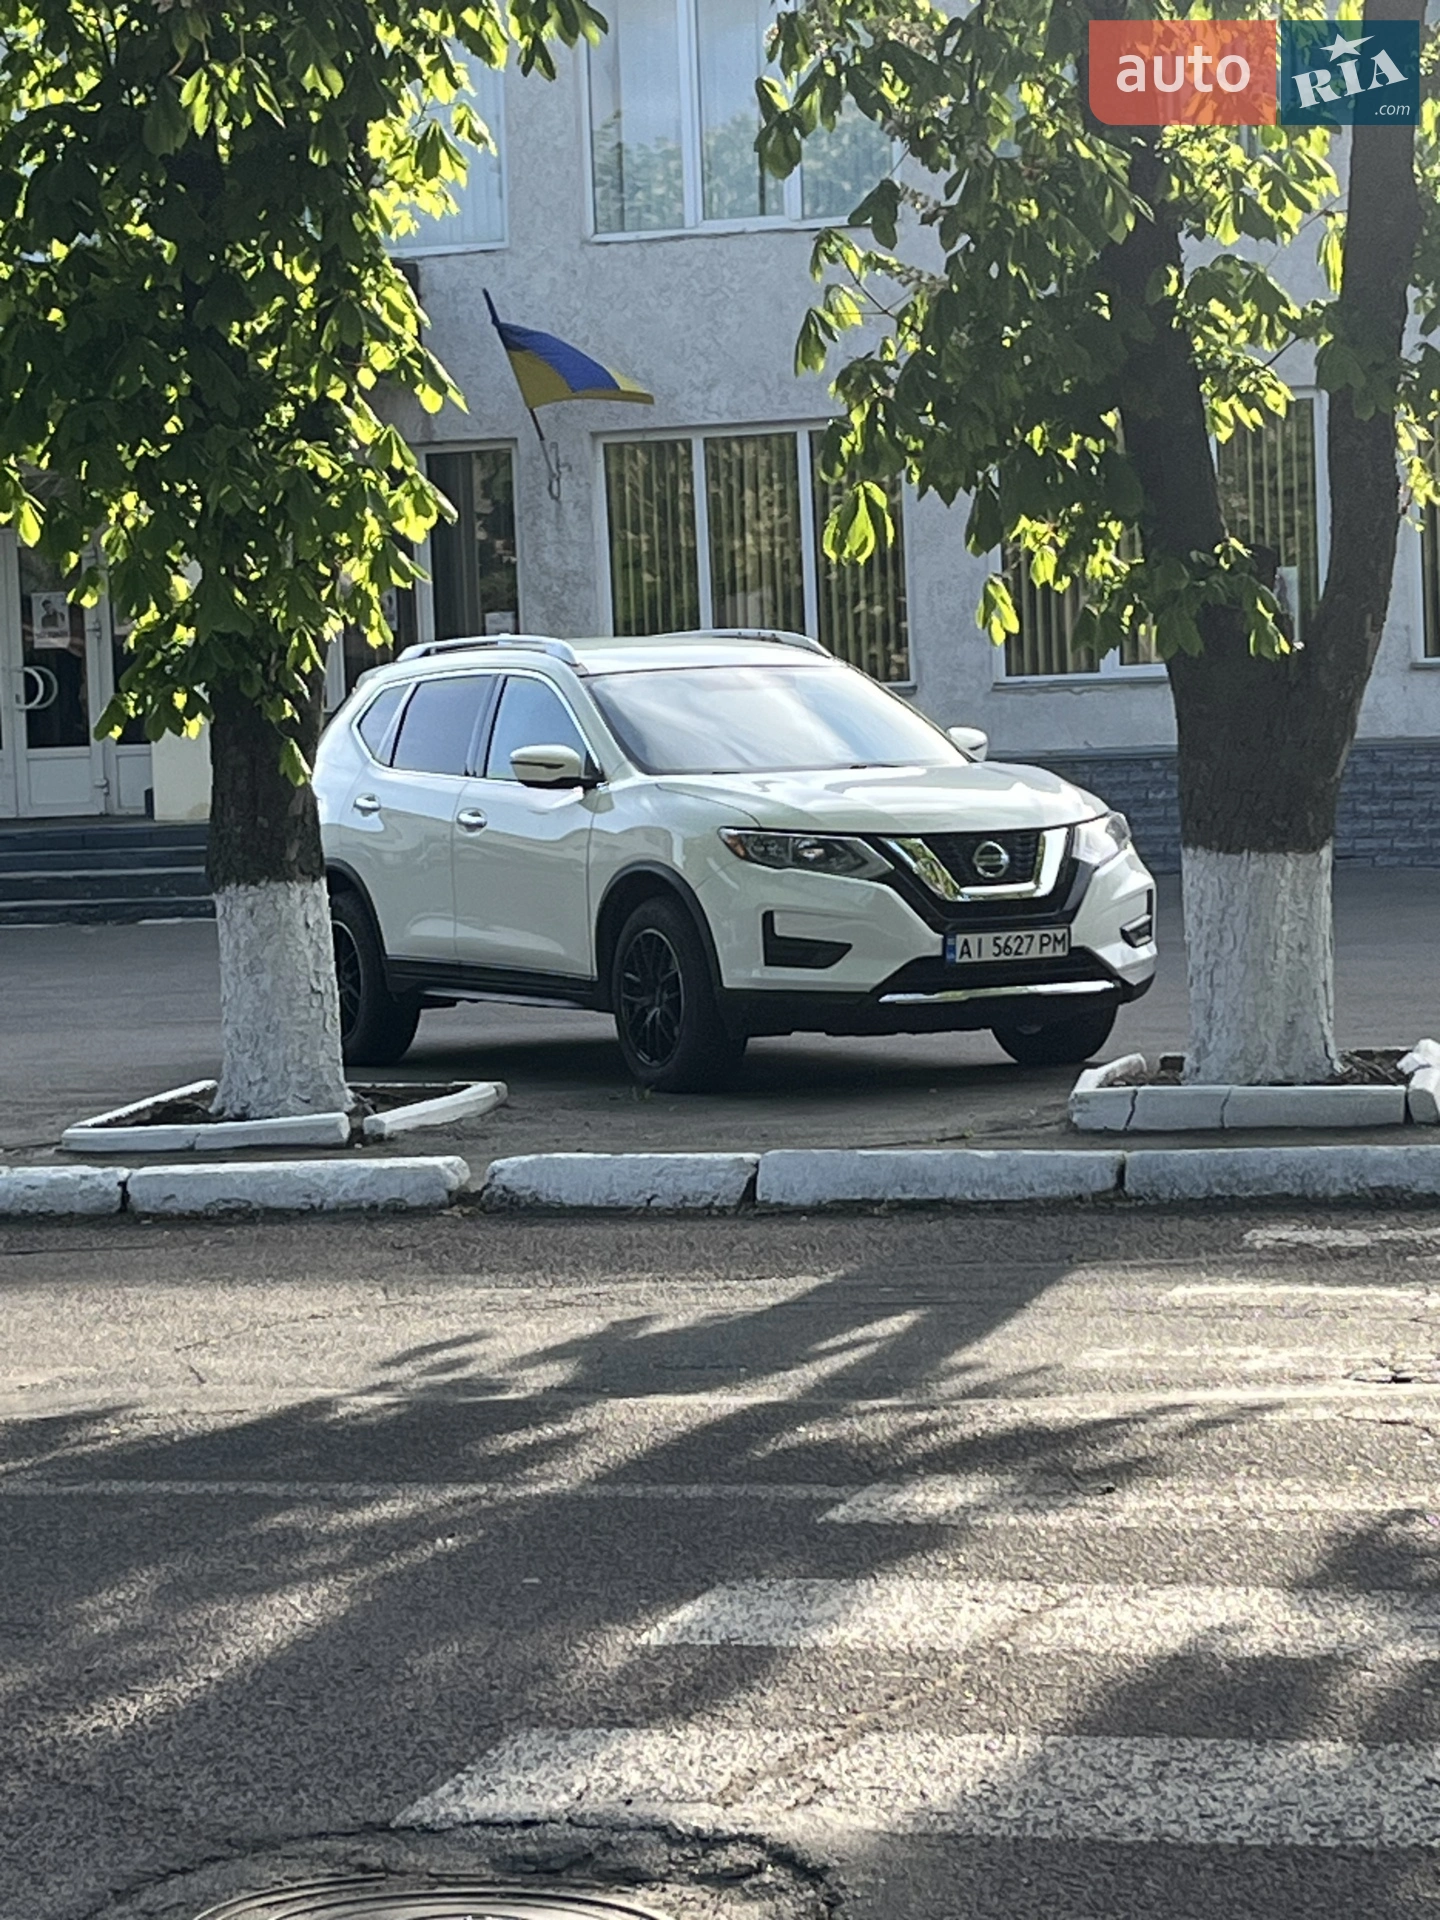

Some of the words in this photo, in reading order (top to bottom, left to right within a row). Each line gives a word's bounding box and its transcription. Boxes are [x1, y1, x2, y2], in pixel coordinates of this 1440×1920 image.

[959, 938, 982, 959] AI
[992, 934, 1035, 957] 5627
[1040, 932, 1066, 954] PM
